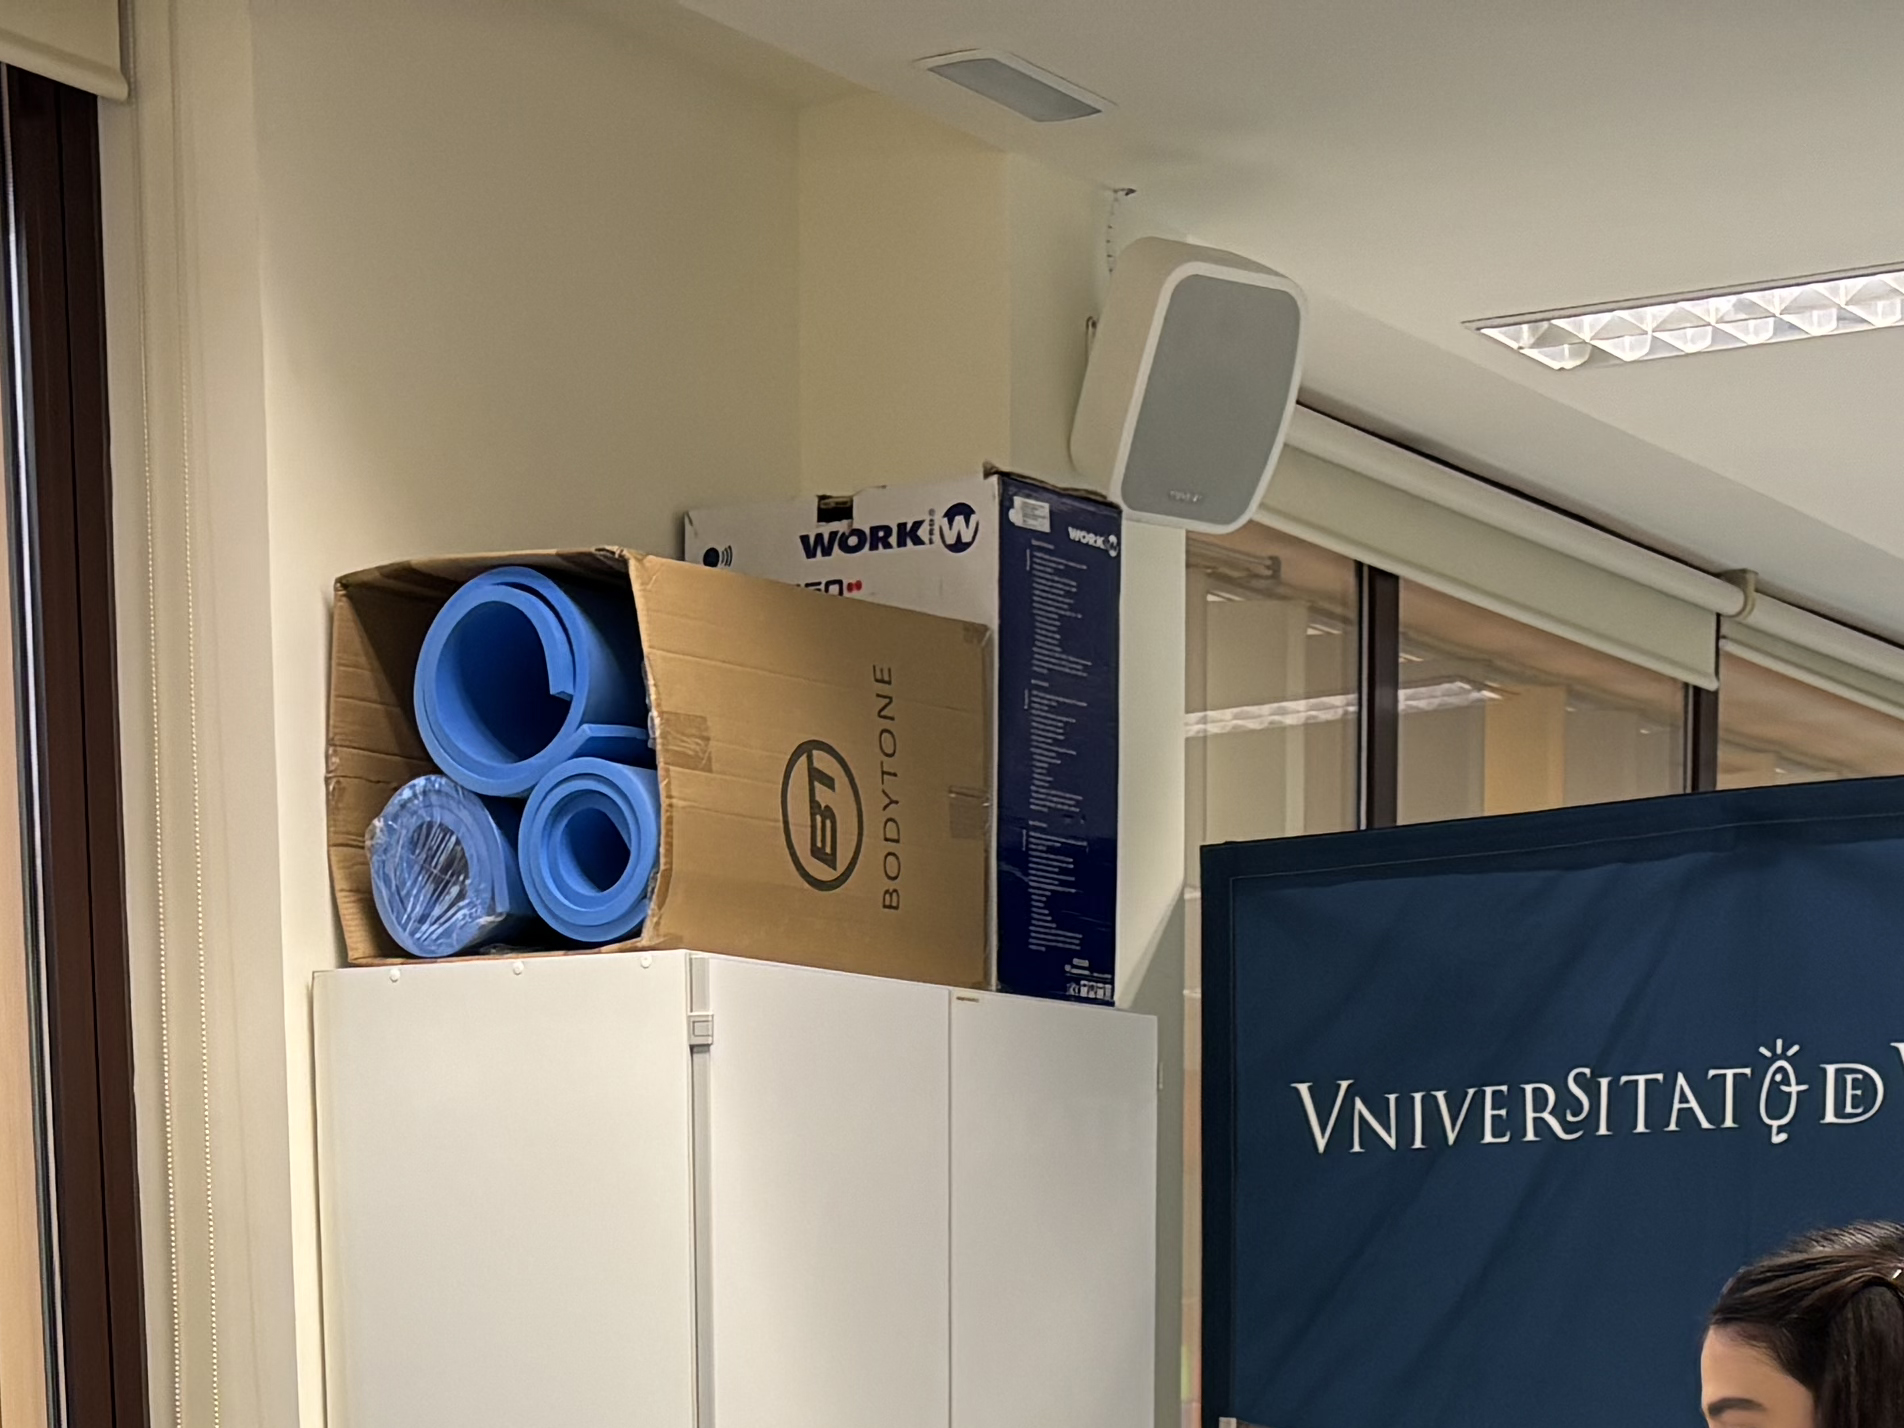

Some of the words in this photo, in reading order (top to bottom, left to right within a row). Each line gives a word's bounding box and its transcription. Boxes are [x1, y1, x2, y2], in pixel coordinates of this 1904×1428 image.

[798, 518, 928, 560] WORK
[1068, 526, 1107, 549] WORK
[872, 664, 902, 911] BODYTONE
